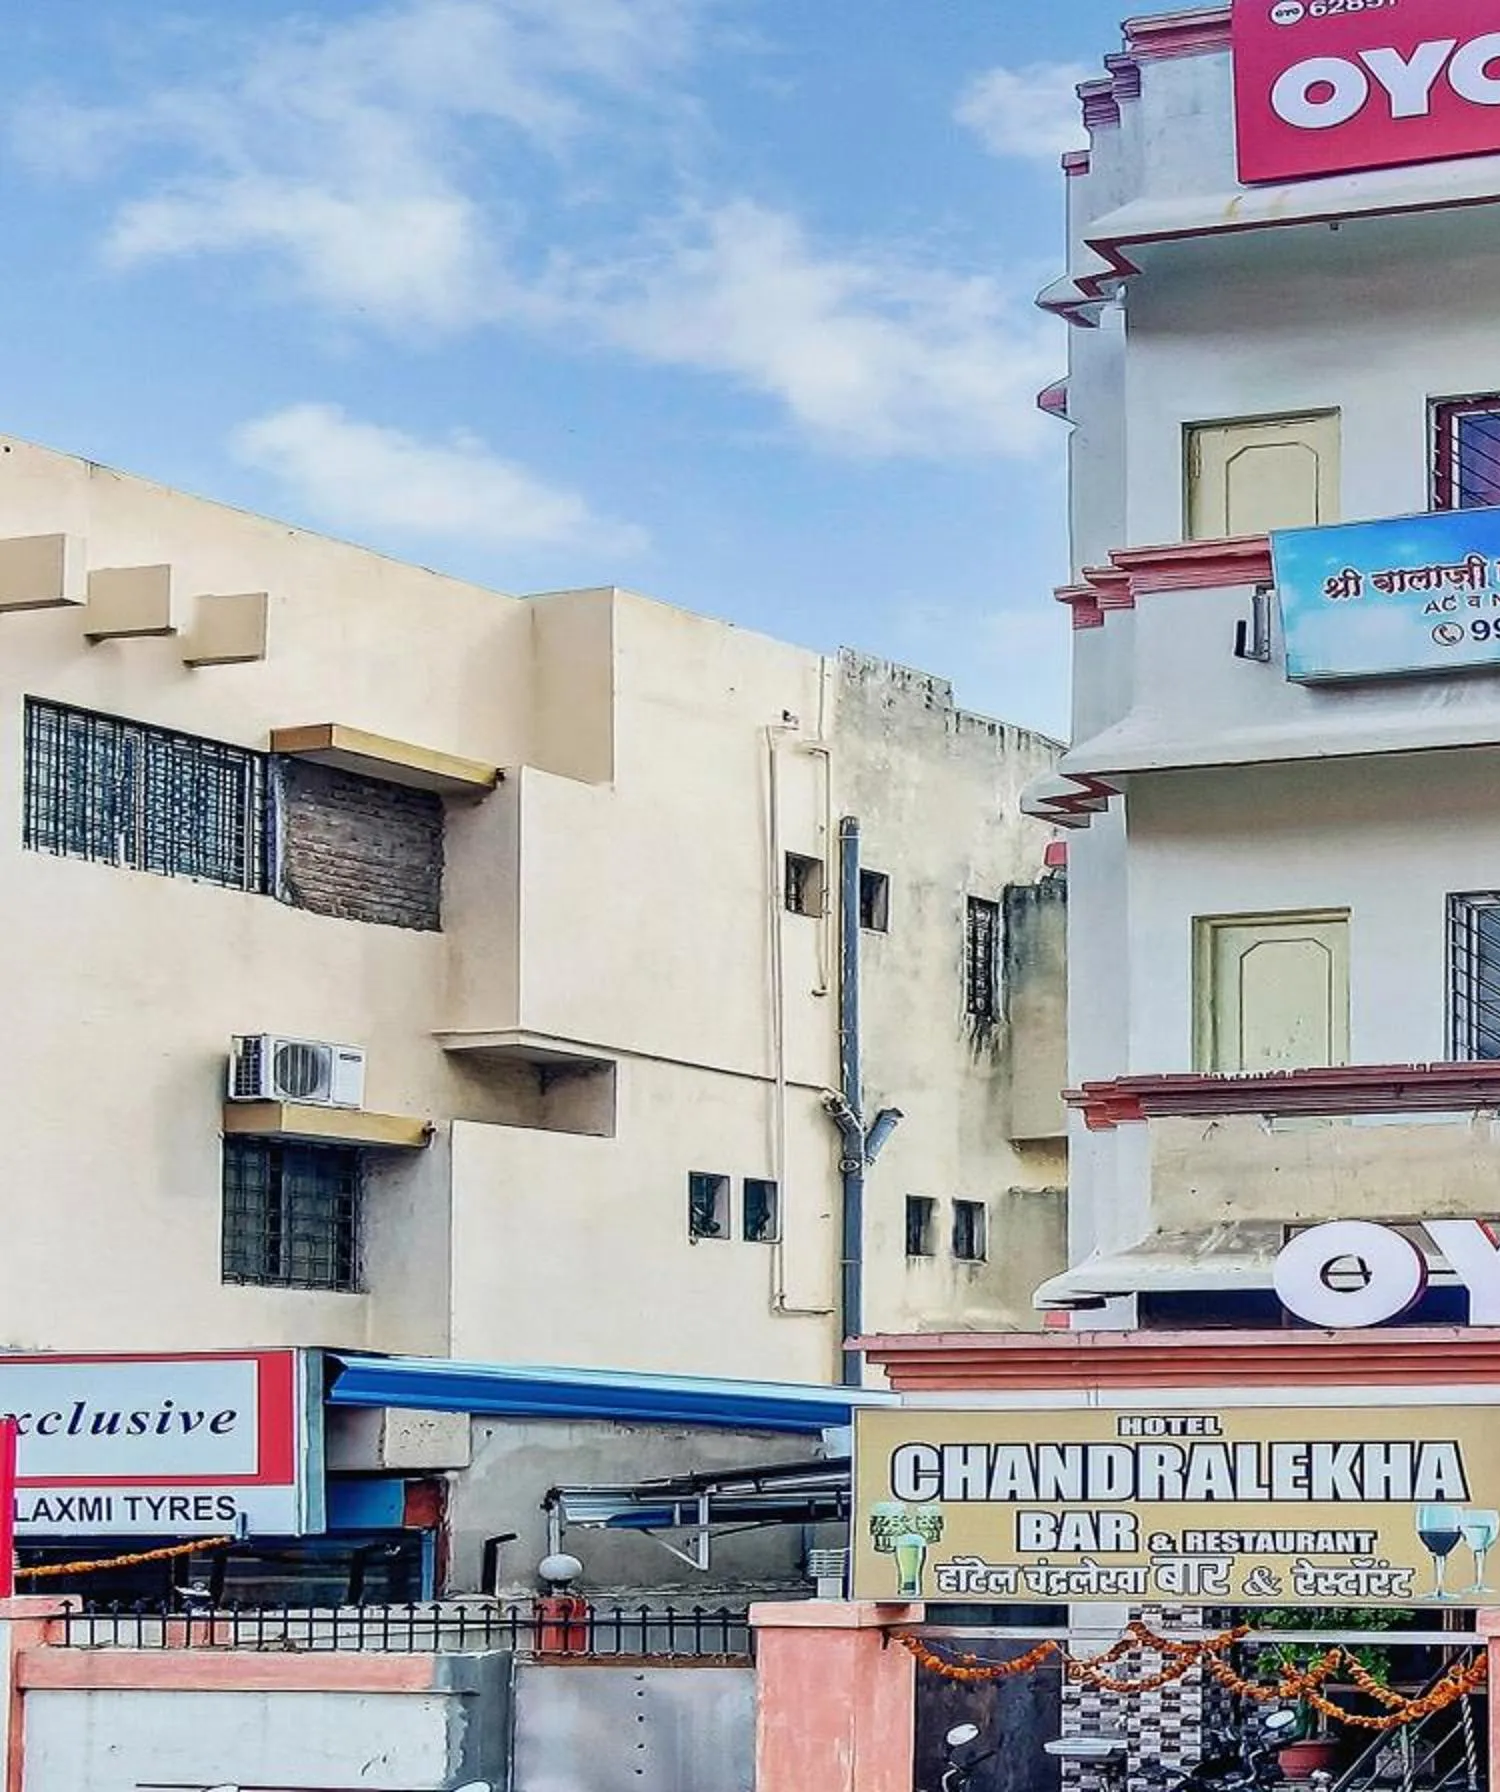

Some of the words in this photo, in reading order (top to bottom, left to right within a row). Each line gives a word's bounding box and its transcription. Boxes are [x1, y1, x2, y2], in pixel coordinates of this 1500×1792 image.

[1325, 567, 1362, 599] श्री
[1372, 553, 1487, 594] बालाजी
[1424, 595, 1457, 614] AC
[1467, 594, 1481, 608] व
[1117, 1415, 1223, 1437] HOTEL
[891, 1440, 1470, 1502] CHANDRALEKHA
[14, 1496, 112, 1522] LAXMI
[123, 1495, 237, 1521] TYRES
[1016, 1510, 1140, 1554] BAR
[1148, 1533, 1176, 1554] &
[1183, 1531, 1378, 1554] RESTAURANT
[934, 1556, 1020, 1594] हॉटेल
[1022, 1556, 1150, 1595] चंद्रलेखा
[1151, 1556, 1234, 1595] बार
[1242, 1566, 1282, 1596] &
